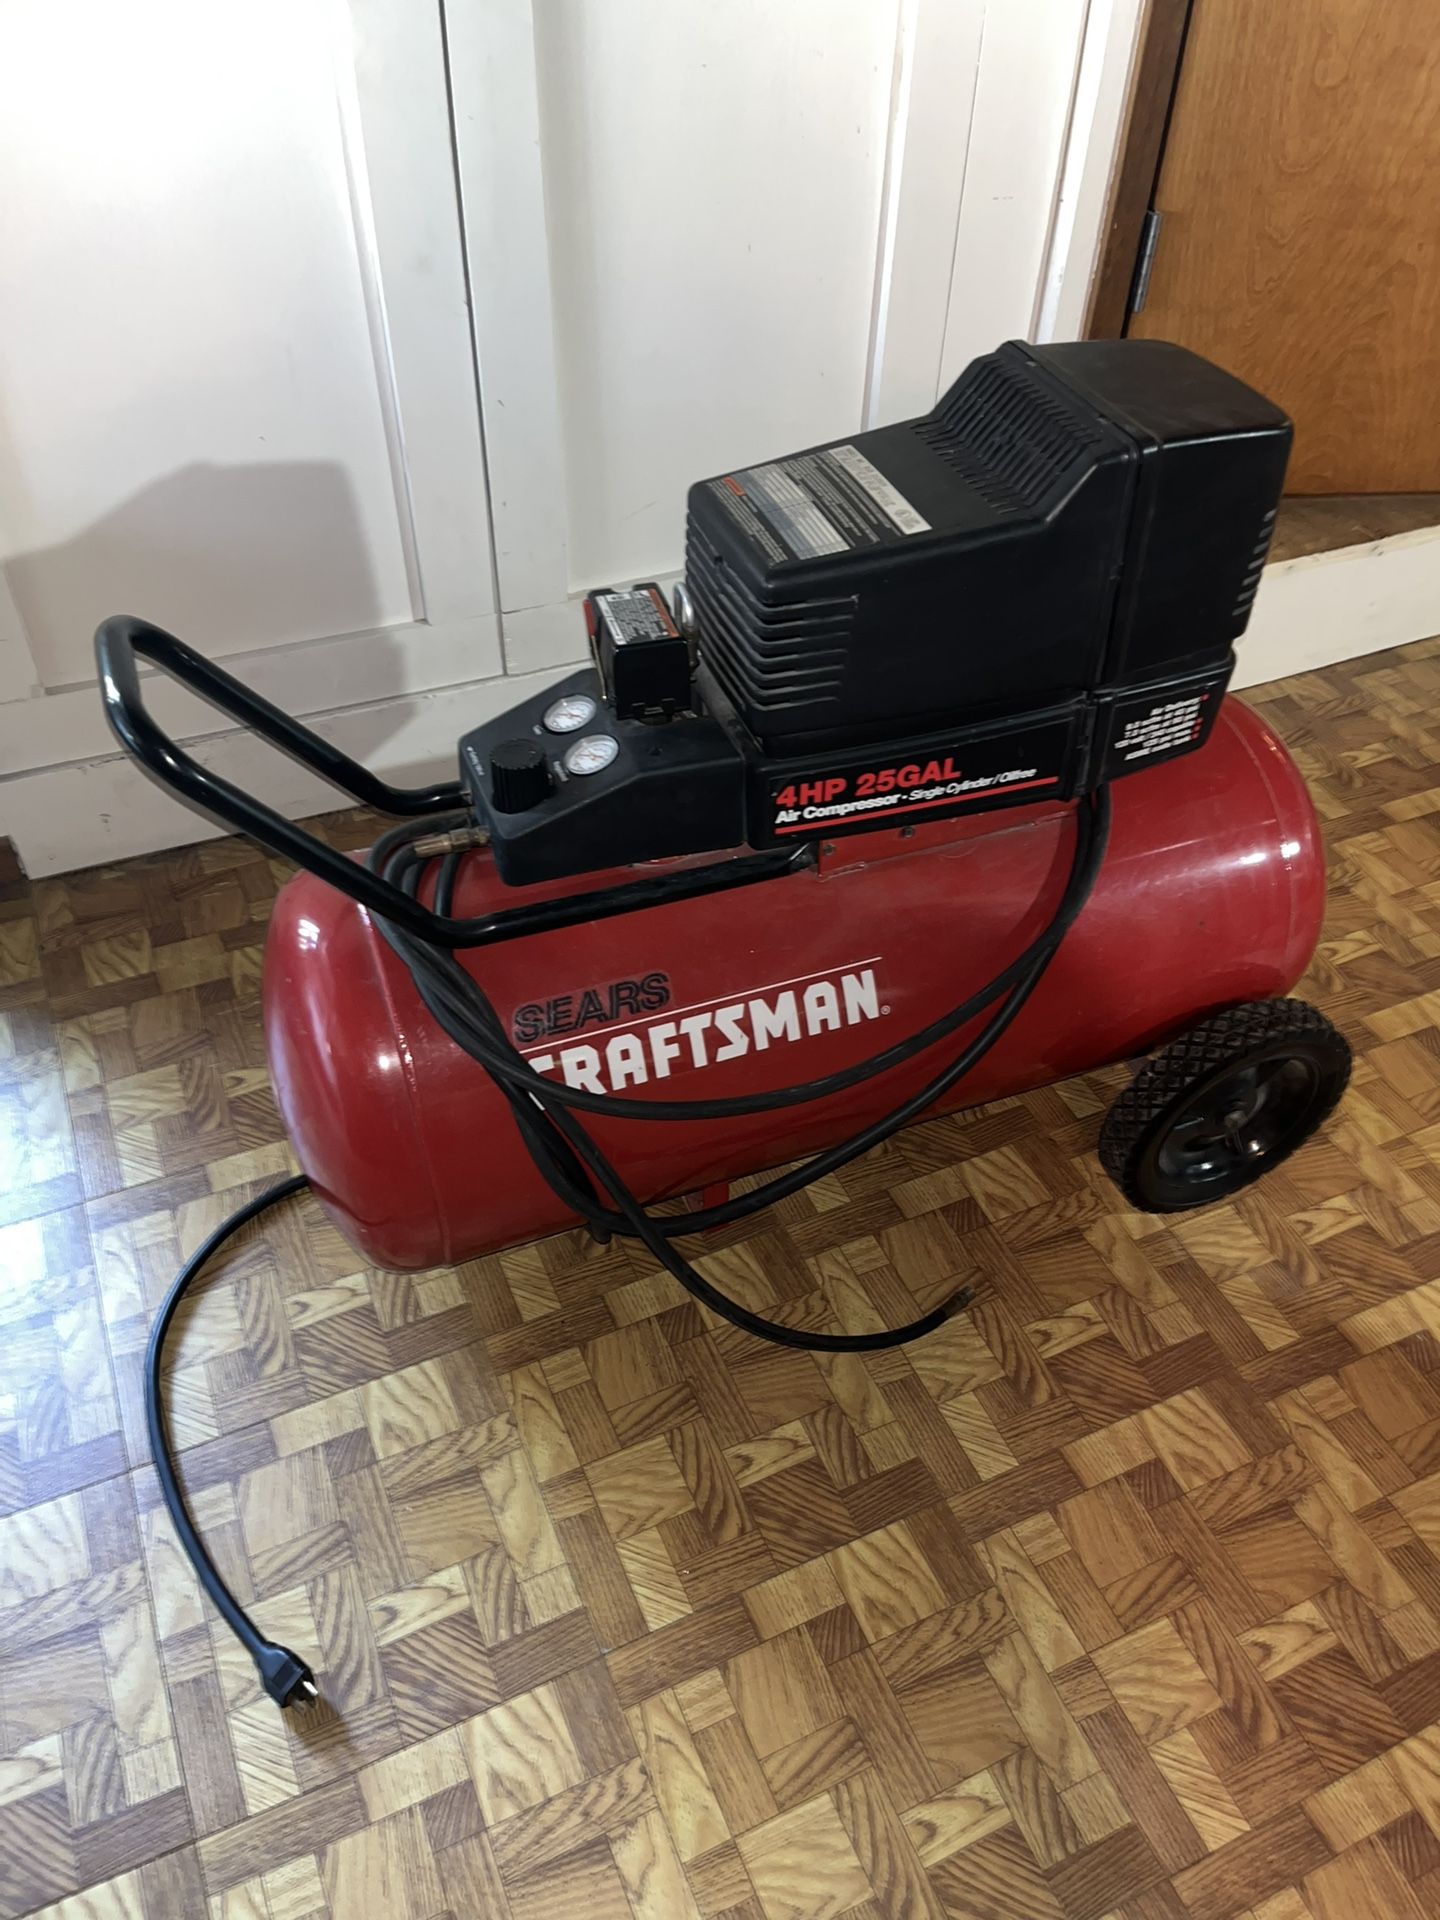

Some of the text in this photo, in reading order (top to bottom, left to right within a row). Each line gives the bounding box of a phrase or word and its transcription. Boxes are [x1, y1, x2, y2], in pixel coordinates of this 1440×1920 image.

[774, 808, 802, 824] Air
[803, 793, 902, 820] Compressor
[908, 785, 945, 802] Single
[945, 776, 994, 795] Cylinder
[776, 757, 962, 808] 4HP 25GAL
[513, 971, 671, 1044] SEARS
